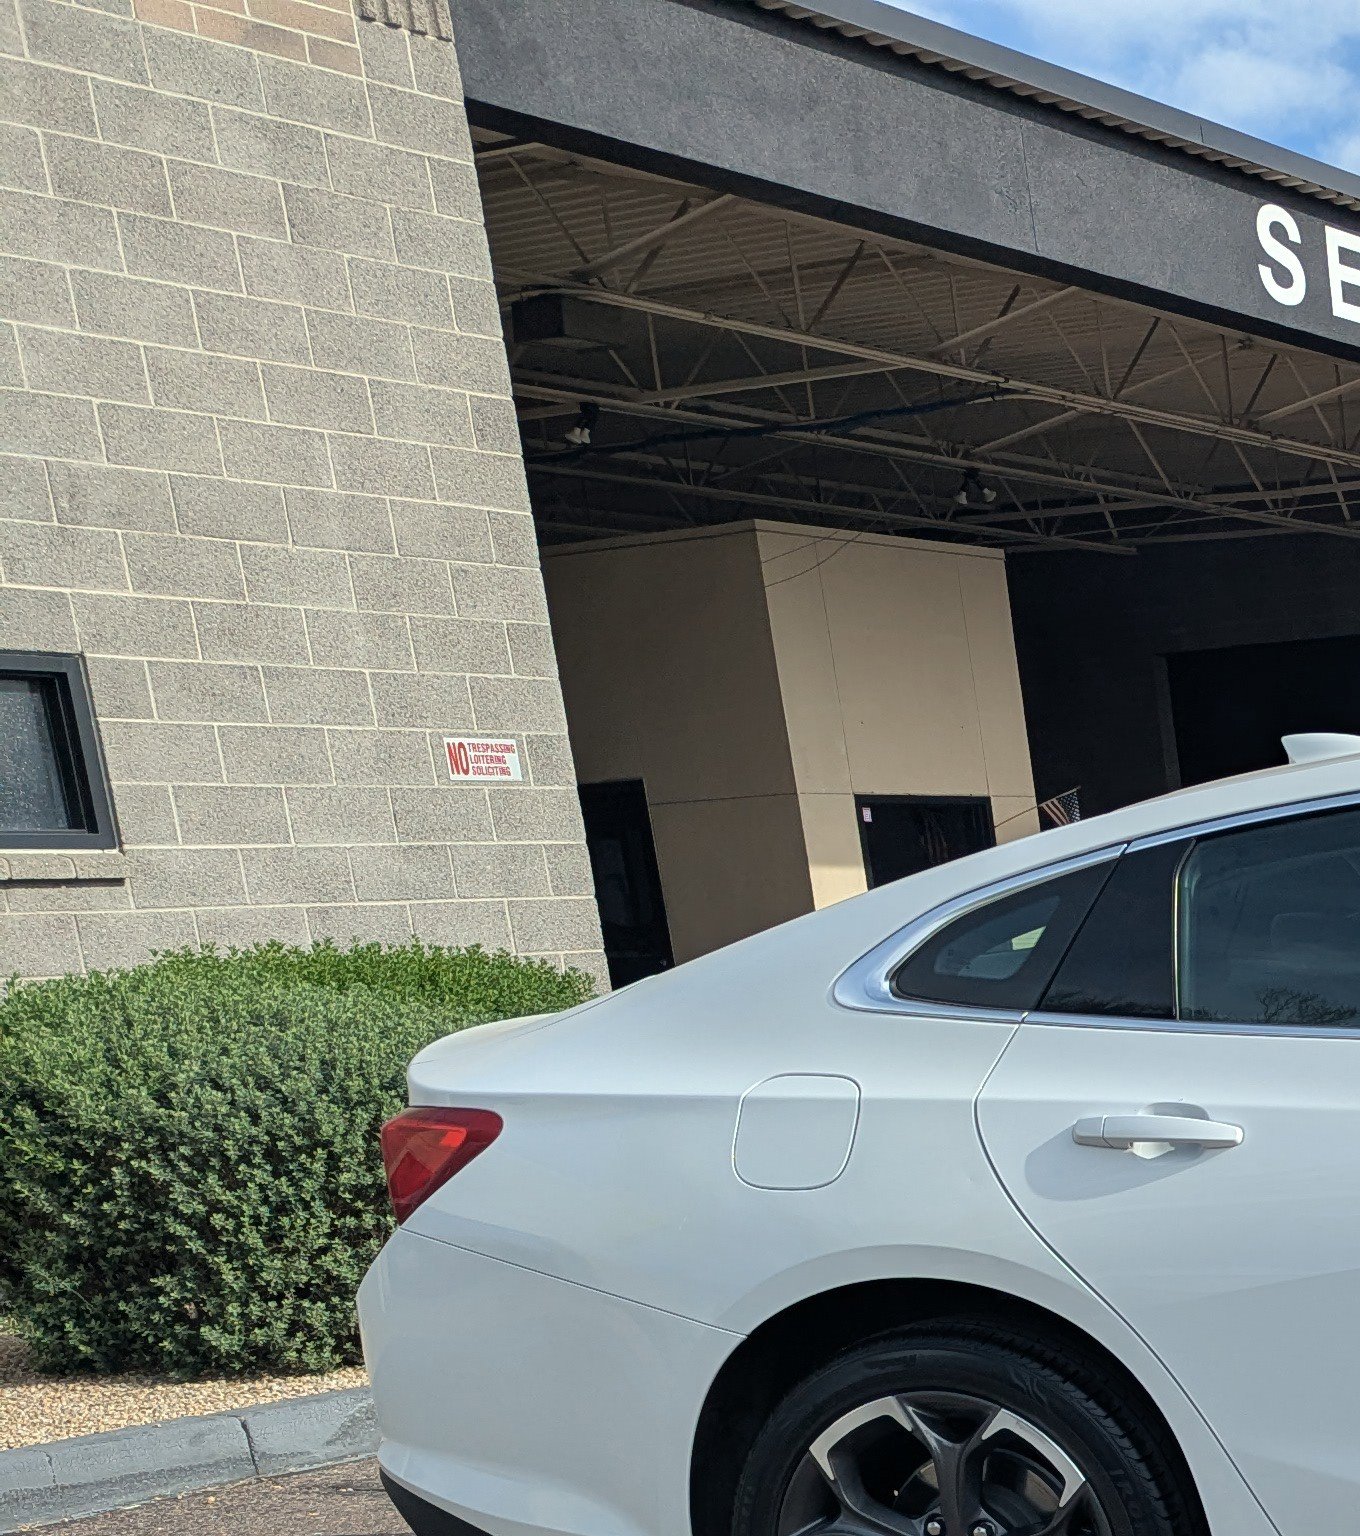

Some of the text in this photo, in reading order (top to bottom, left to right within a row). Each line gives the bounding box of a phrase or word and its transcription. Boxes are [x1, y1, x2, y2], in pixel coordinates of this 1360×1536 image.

[467, 743, 516, 754] TRESPASSING
[446, 741, 470, 776] NO
[469, 754, 507, 765] LOITERING
[471, 765, 512, 776] SOLICITING
